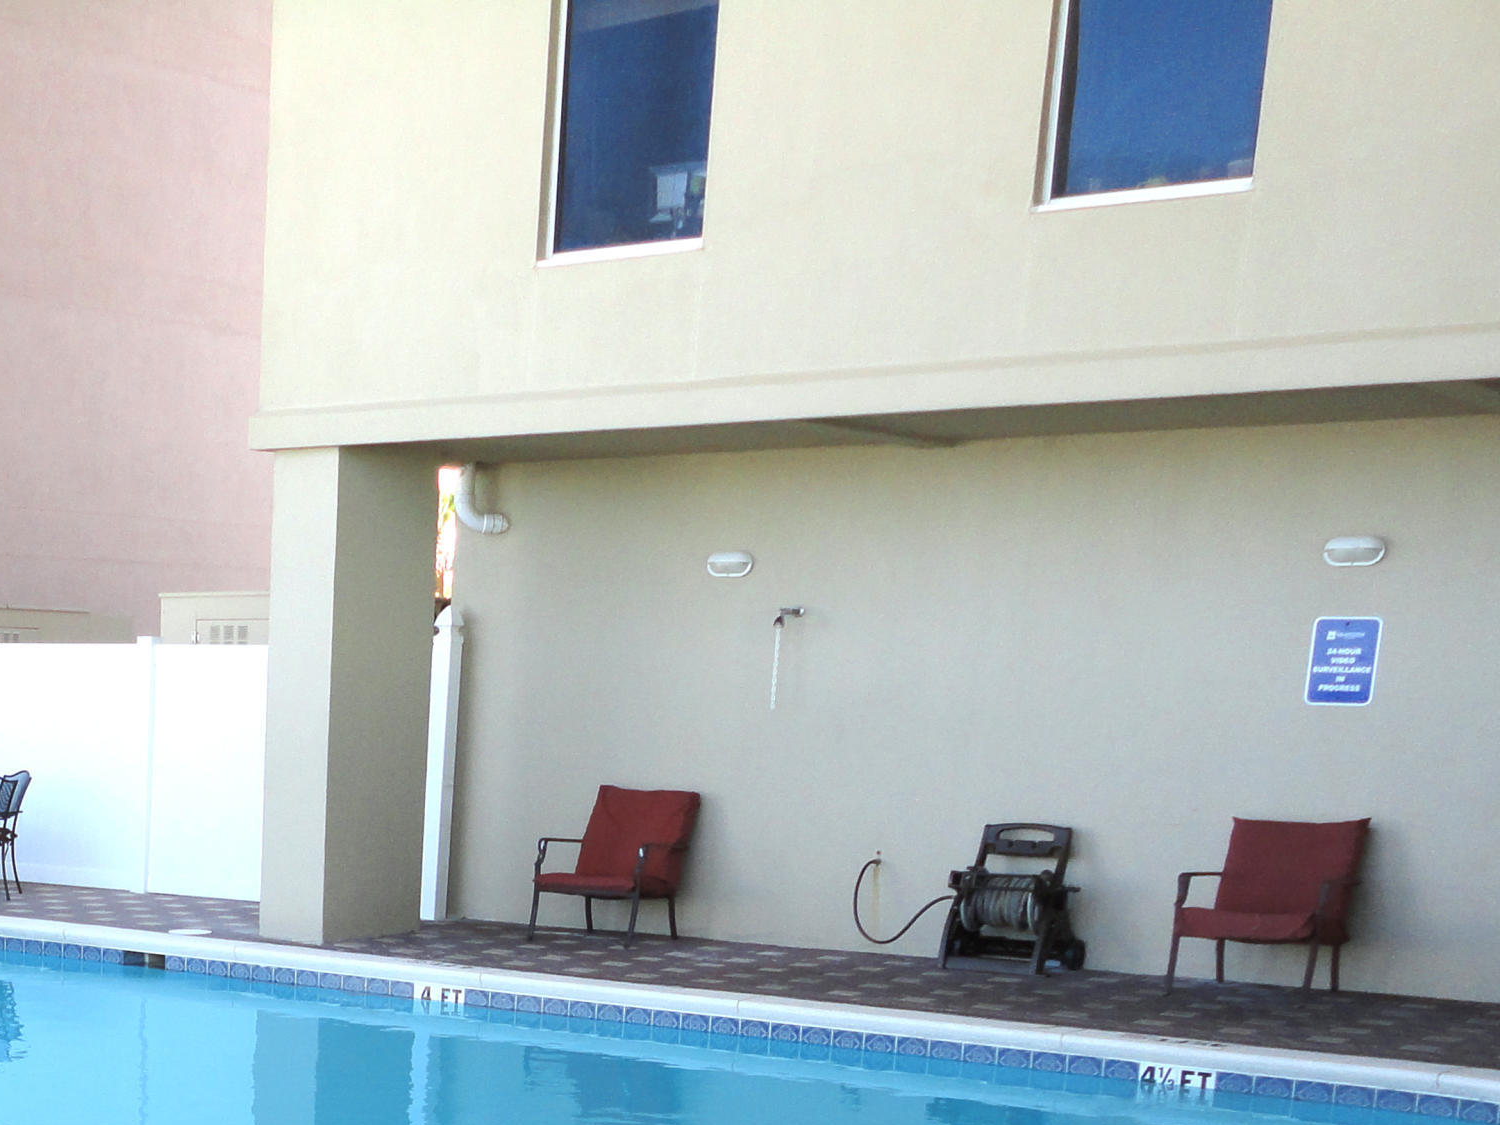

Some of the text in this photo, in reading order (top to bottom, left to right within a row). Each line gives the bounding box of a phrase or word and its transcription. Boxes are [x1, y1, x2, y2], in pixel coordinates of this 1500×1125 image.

[1313, 666, 1372, 674] SURVEILLANCE
[1317, 684, 1361, 692] PROGRESS
[421, 986, 462, 1004] 4 FT
[1180, 1070, 1212, 1090] FT
